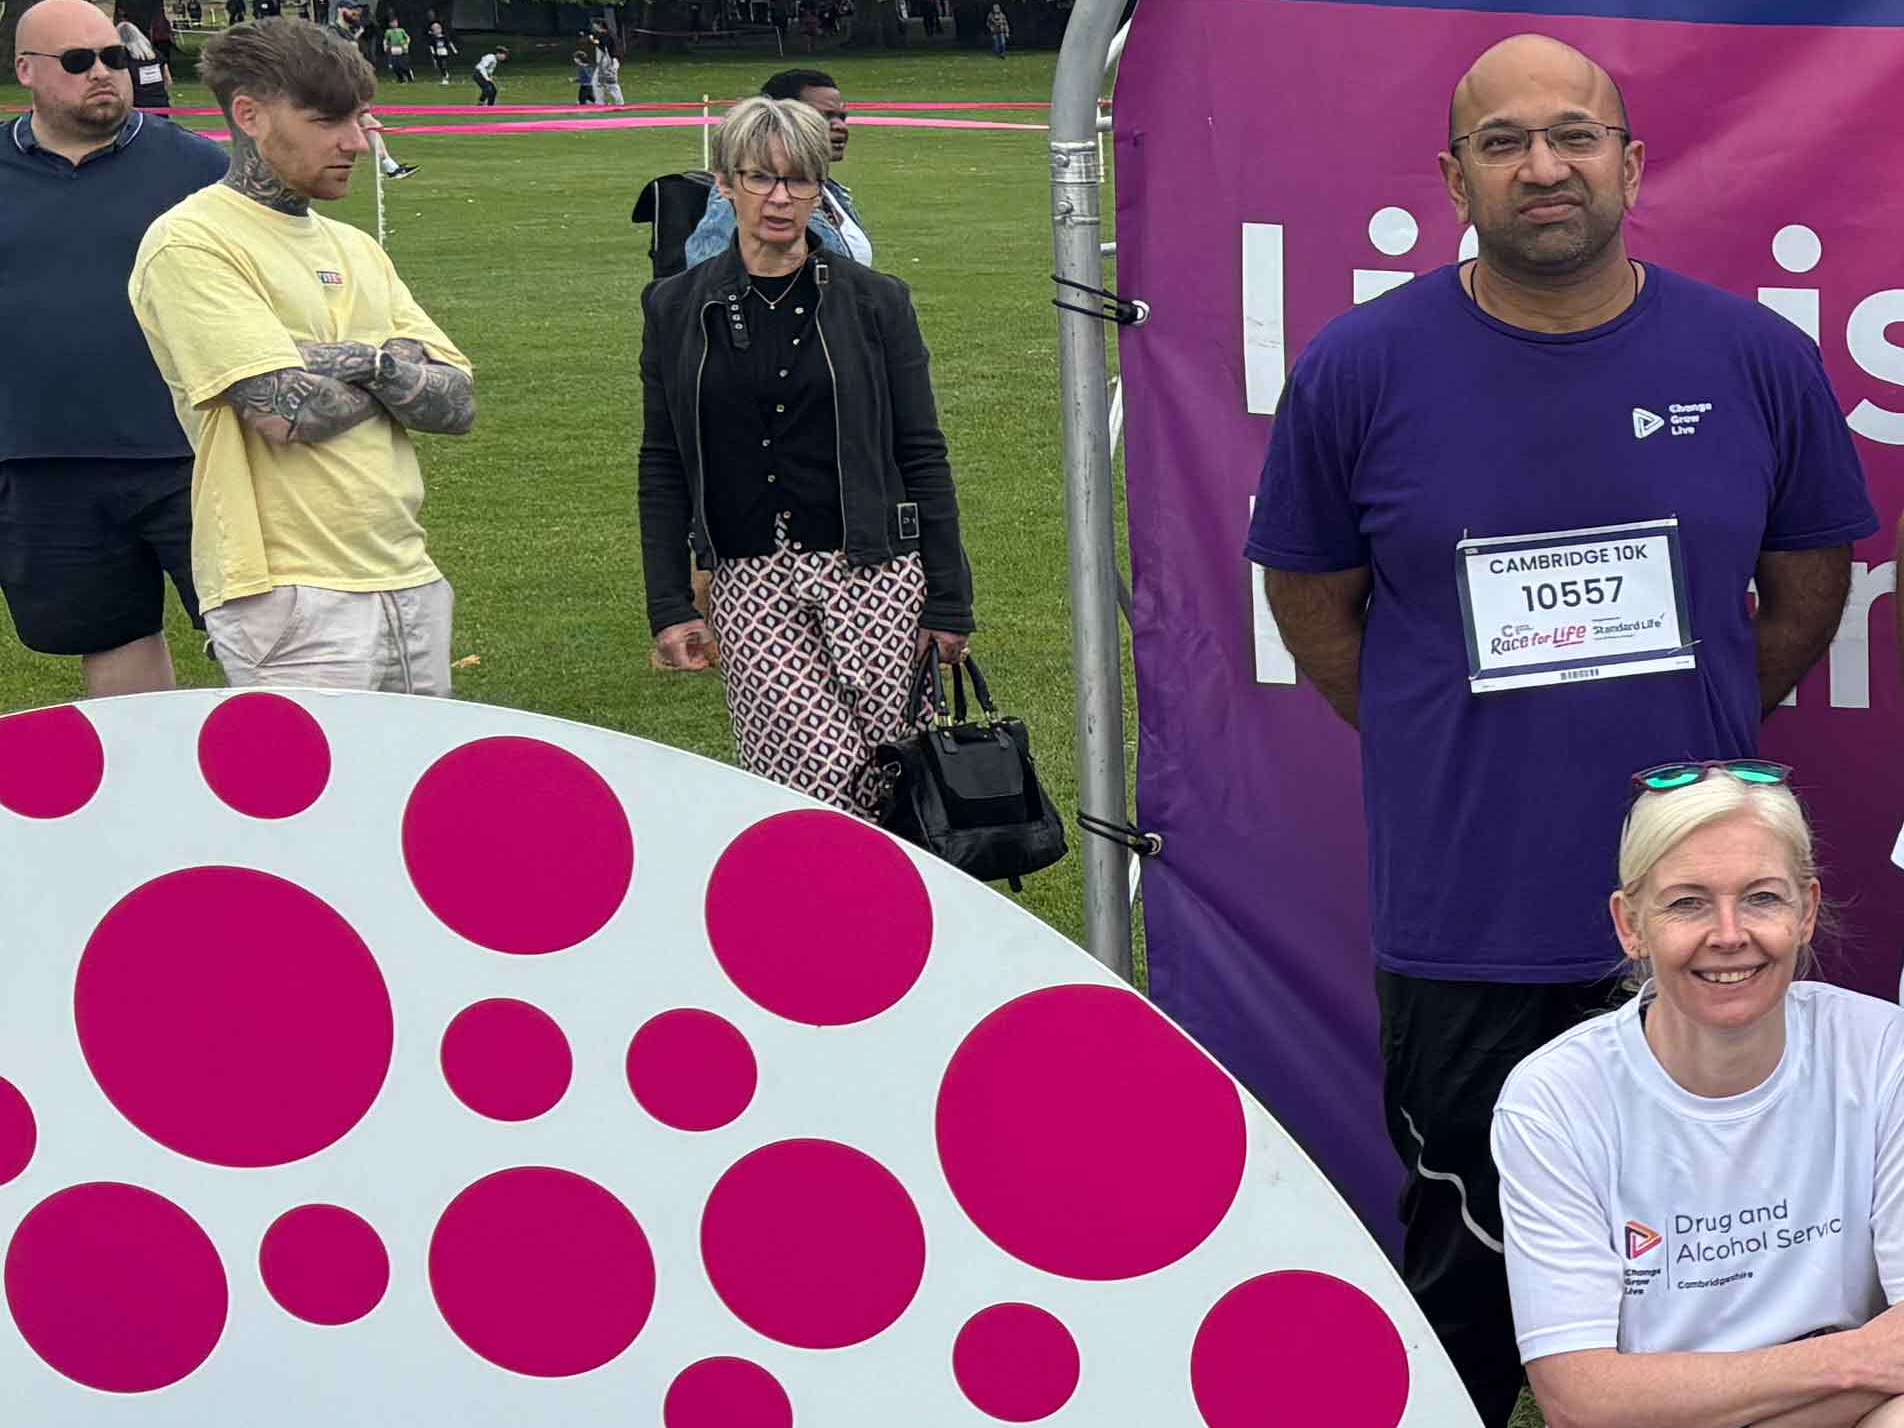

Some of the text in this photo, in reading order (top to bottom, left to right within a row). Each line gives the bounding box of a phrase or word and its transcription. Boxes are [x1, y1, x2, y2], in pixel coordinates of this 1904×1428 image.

[1490, 544, 1648, 574] CAMBRIDGE 10K
[1522, 576, 1624, 612] 10557
[1490, 635, 1529, 655] Race
[1531, 632, 1552, 647] for
[1552, 624, 1586, 646] Life
[1675, 1199, 1788, 1234] Drug and
[1676, 1218, 1842, 1264] Alcohol Servic
